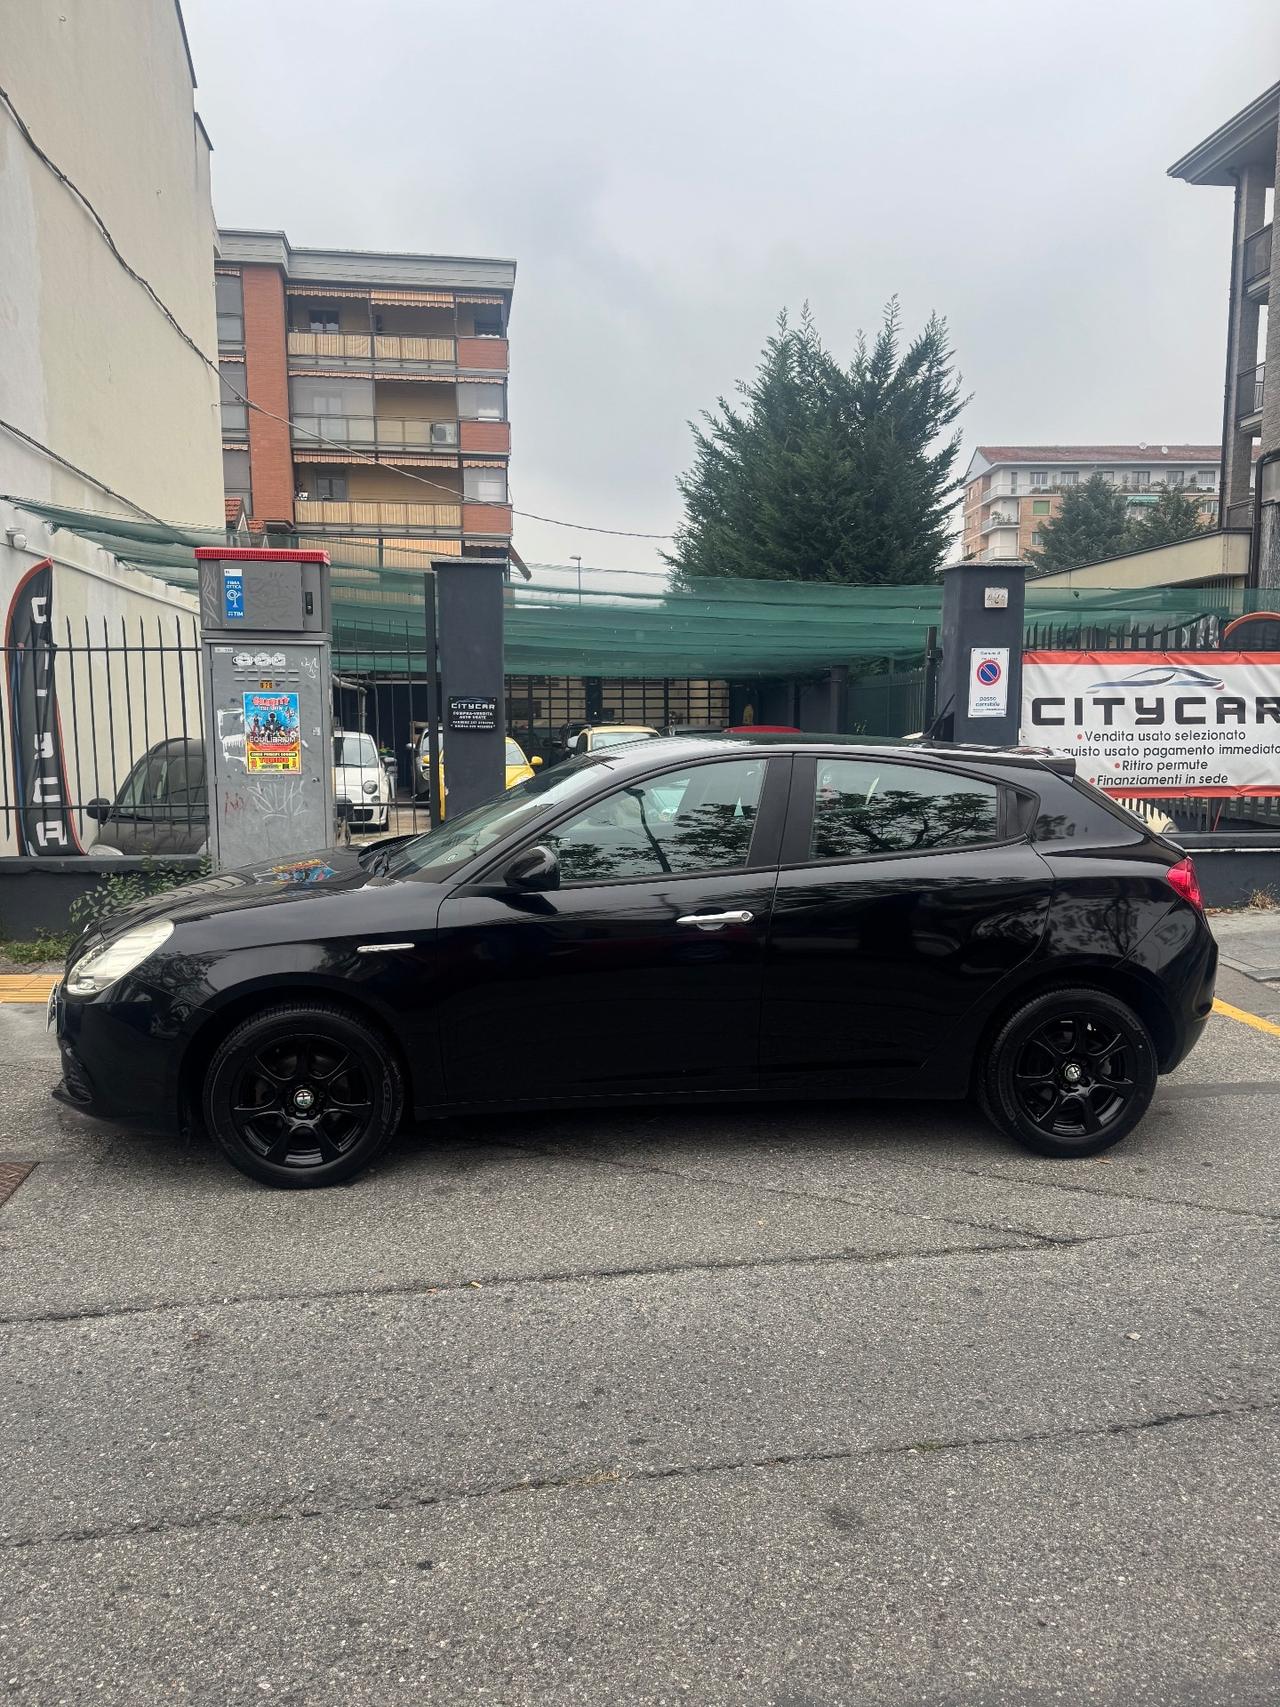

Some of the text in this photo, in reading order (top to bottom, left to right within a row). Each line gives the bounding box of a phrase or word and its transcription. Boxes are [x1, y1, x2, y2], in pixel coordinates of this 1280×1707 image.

[1032, 697, 1280, 725] CITYCAR
[1085, 730, 1246, 742] Vendita usato selezionato
[1104, 745, 1139, 757] usato
[1143, 744, 1215, 758] pagamento
[1122, 759, 1208, 772] Ritiro permute
[1097, 773, 1229, 786] Finanziamenti in sede
